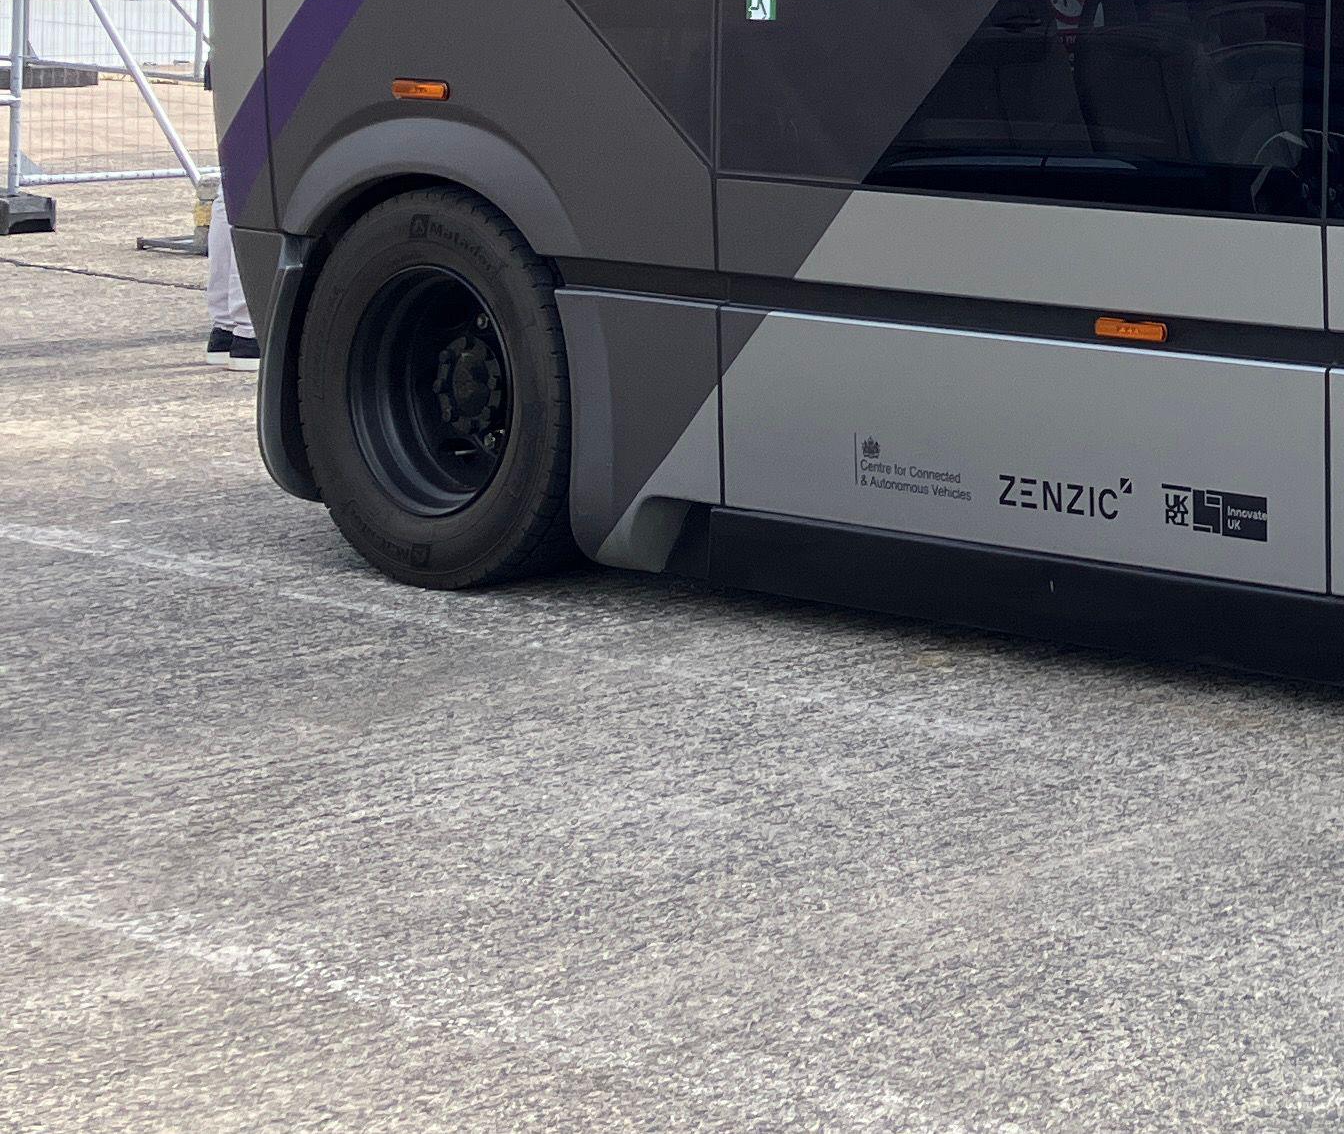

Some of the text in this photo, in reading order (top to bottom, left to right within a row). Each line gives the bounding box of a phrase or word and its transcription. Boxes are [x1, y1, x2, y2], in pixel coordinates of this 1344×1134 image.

[860, 459, 961, 484] Centre for Connected
[860, 474, 972, 502] & Autonomous Vehicles
[999, 474, 1120, 521] ZENZIC
[1226, 505, 1267, 522] Innovate
[1227, 518, 1242, 532] UK
